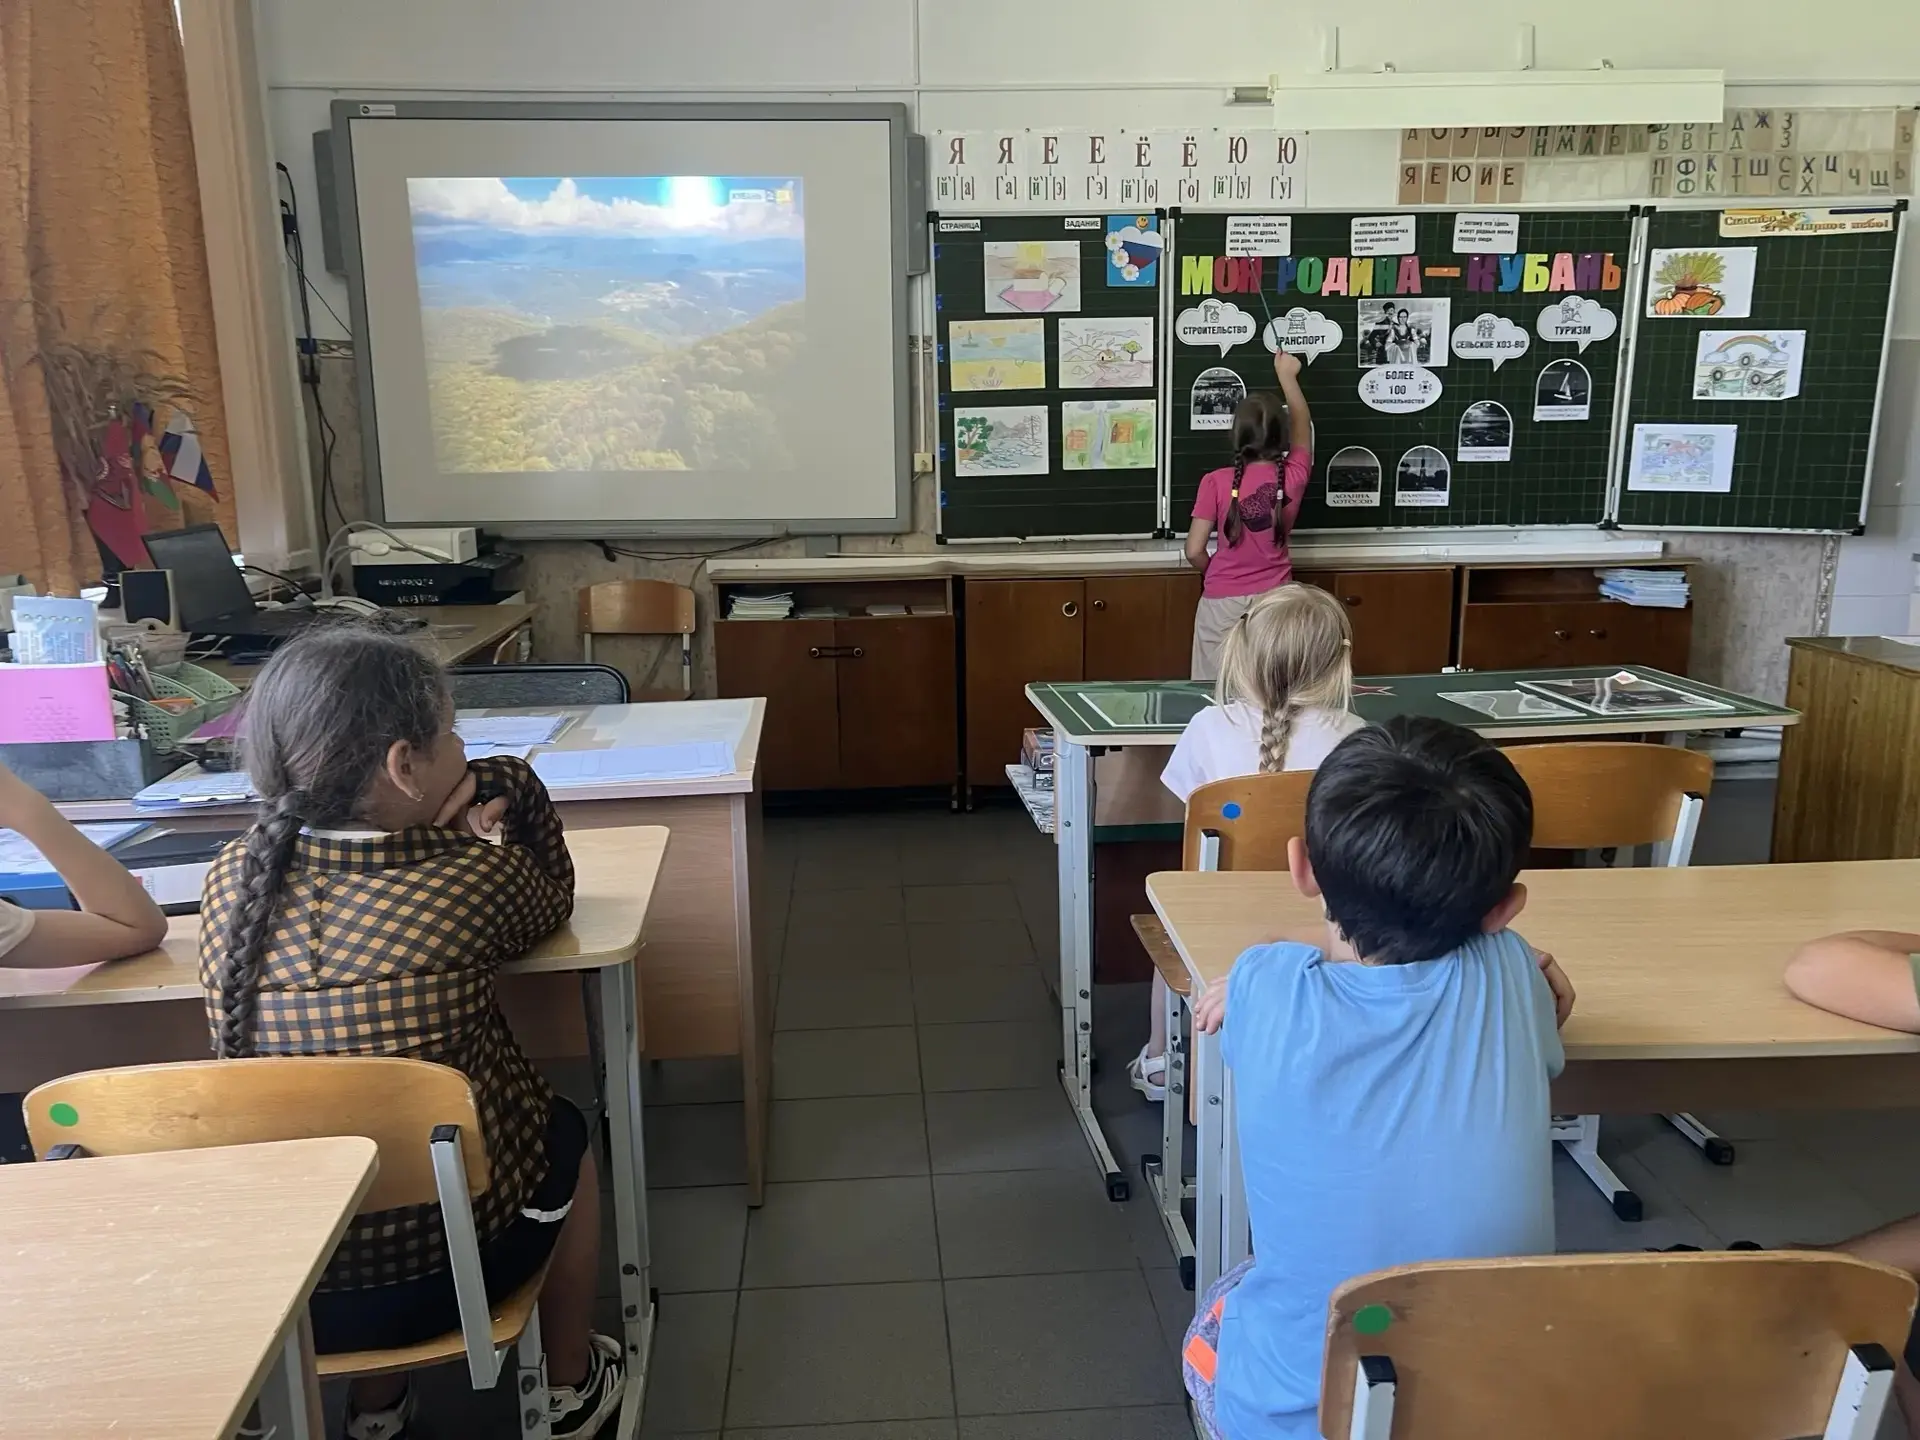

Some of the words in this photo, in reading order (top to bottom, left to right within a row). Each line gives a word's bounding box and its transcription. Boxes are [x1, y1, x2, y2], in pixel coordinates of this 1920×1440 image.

[1731, 116, 1744, 131] Д
[1755, 113, 1770, 129] Ж
[1784, 113, 1793, 131] З
[1534, 136, 1547, 156] Н
[1557, 134, 1574, 152] М
[1609, 135, 1620, 153] Р
[1658, 133, 1669, 150] Б
[1682, 133, 1692, 150] В
[1708, 133, 1718, 150] Г
[1730, 132, 1742, 149] Д
[1781, 132, 1791, 148] З
[949, 137, 965, 164] Я
[997, 137, 1014, 164] Я
[1042, 136, 1059, 164] Е
[1088, 136, 1106, 164] Е
[1135, 136, 1151, 167] Ё
[1181, 136, 1197, 167] Ё
[1228, 136, 1247, 164] Ю
[1277, 137, 1297, 164] Ю
[1653, 160, 1665, 174] П
[1677, 158, 1695, 175] Ф
[1707, 154, 1717, 172] К
[1732, 157, 1742, 174] Т
[1750, 158, 1768, 176] Ш
[1779, 156, 1791, 173] С
[1803, 157, 1815, 173] Х
[1826, 156, 1837, 172] Ц
[1405, 167, 1416, 184] Я
[1431, 167, 1441, 185] Е
[1452, 165, 1471, 182] Ю
[1480, 168, 1493, 185] И
[1503, 168, 1514, 185] Е
[1651, 179, 1662, 194] П
[1677, 178, 1695, 194] Ф
[1705, 175, 1715, 191] К
[1731, 175, 1742, 193] Т
[1779, 175, 1790, 191] С
[1801, 178, 1813, 193] Х
[1850, 169, 1860, 185] Ч
[1871, 170, 1888, 187] Щ
[940, 221, 980, 230] СТРАНИЦА
[1066, 220, 1099, 229] ЗАДАНИЕ
[1181, 256, 1263, 295] МОЯ
[1277, 256, 1422, 297] РОДИНА
[1467, 253, 1621, 292] КУБАНЬ
[1183, 325, 1248, 335] СТРОИТЕЛЬСТВО
[1555, 326, 1592, 336] ТУРИЗМ
[1455, 340, 1494, 349] СЕЛЬСКОЕ
[1496, 340, 1526, 349] ХОЗ-ВО
[1385, 371, 1415, 380] БОЛЕЕ
[1389, 385, 1407, 395] 100
